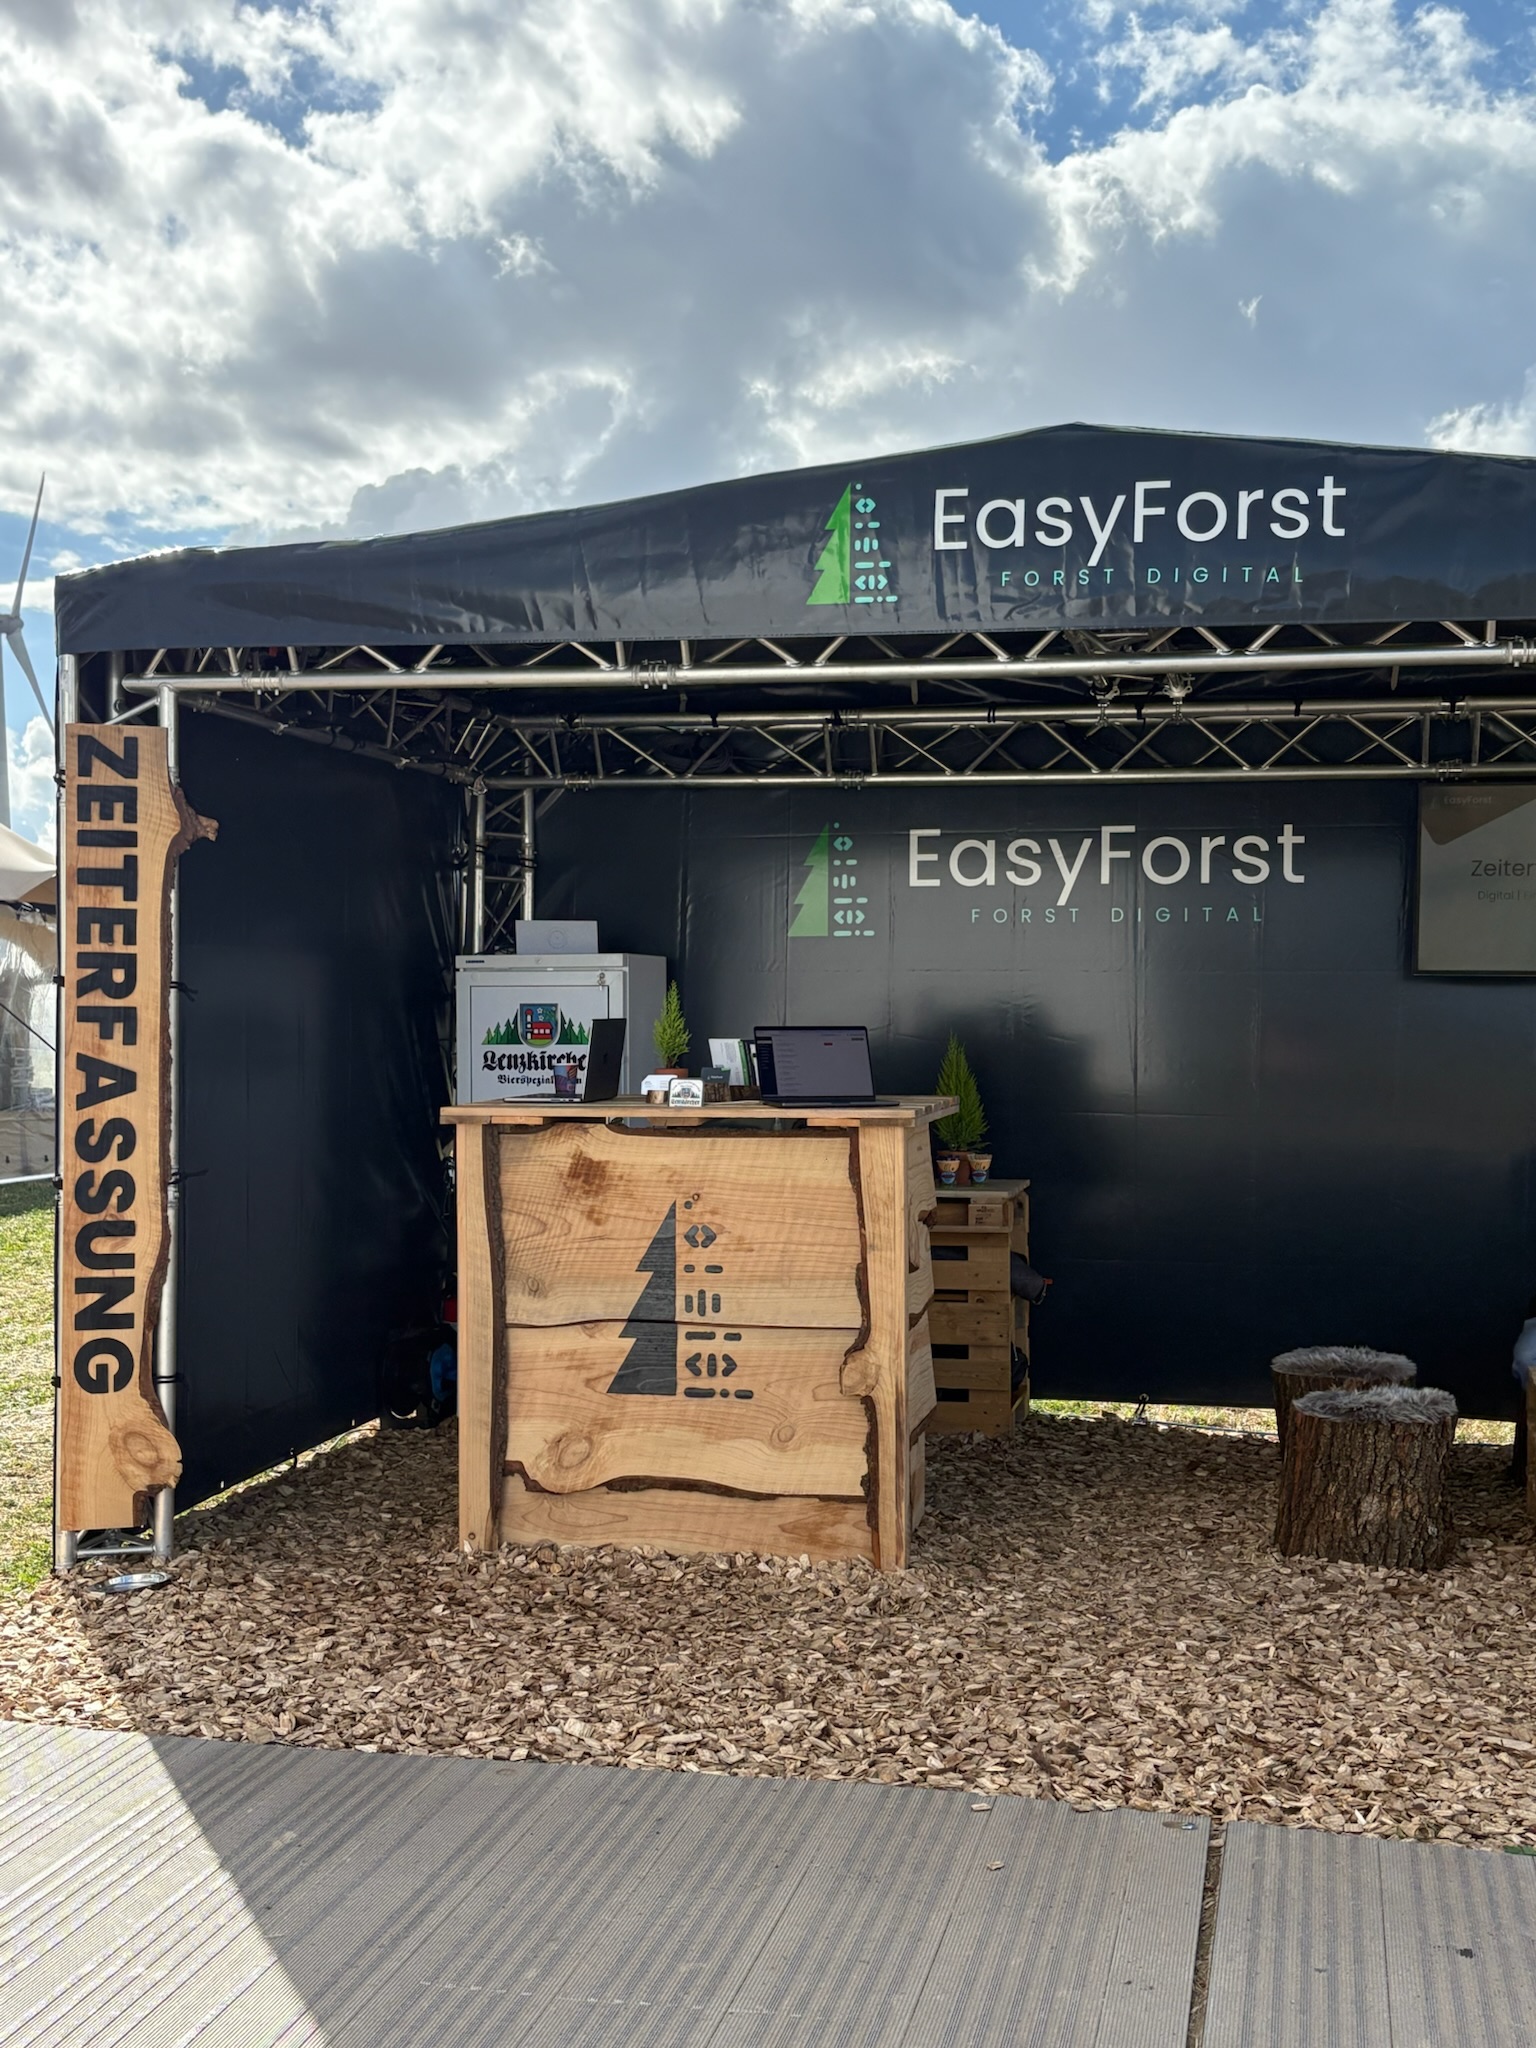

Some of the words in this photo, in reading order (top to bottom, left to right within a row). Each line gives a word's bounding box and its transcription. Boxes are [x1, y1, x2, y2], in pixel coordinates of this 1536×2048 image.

[934, 475, 1347, 567] EasyForst
[999, 566, 1116, 587] FORST
[1145, 563, 1305, 585] DIGITAL
[908, 824, 1306, 907] EasyForst
[1471, 859, 1536, 877] Zeiter
[1477, 889, 1514, 903] Digital
[970, 907, 1081, 925] FORST
[1111, 905, 1264, 924] DIGITAL
[74, 734, 139, 1396] ZEITERFASSUNG
[482, 1050, 587, 1074] Lenzkirche
